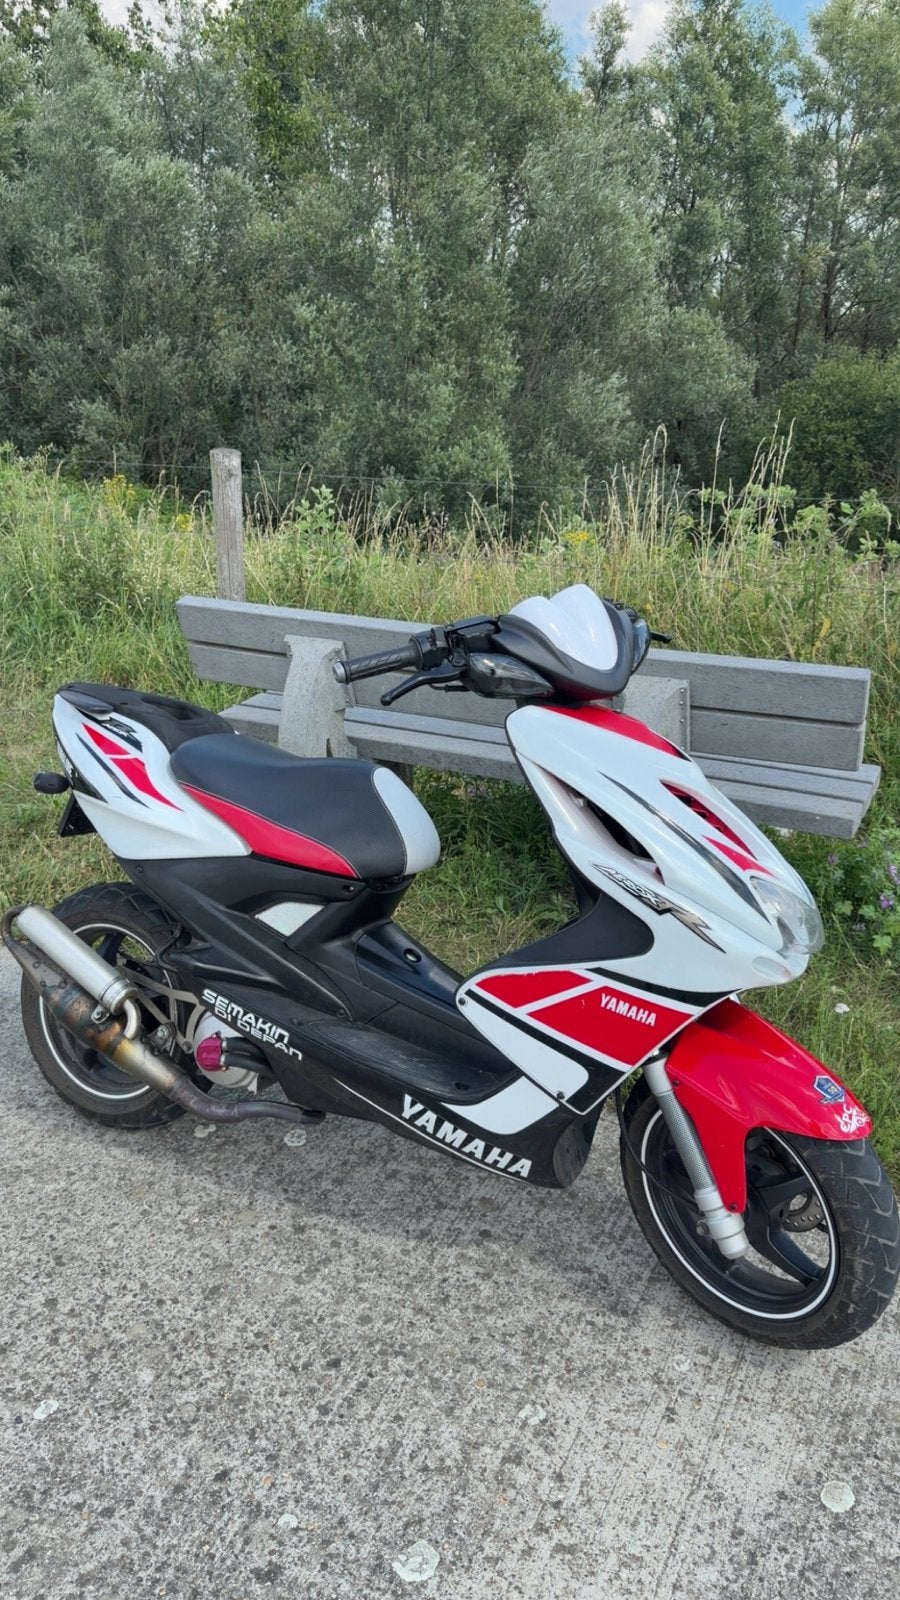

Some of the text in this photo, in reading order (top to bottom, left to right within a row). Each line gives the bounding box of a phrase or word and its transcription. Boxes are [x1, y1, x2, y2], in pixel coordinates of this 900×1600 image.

[202, 988, 290, 1045] SEMAKIN
[600, 992, 657, 1028] YAMAHA
[237, 1020, 303, 1061] DEPAN
[401, 1093, 533, 1178] YAMAHA
